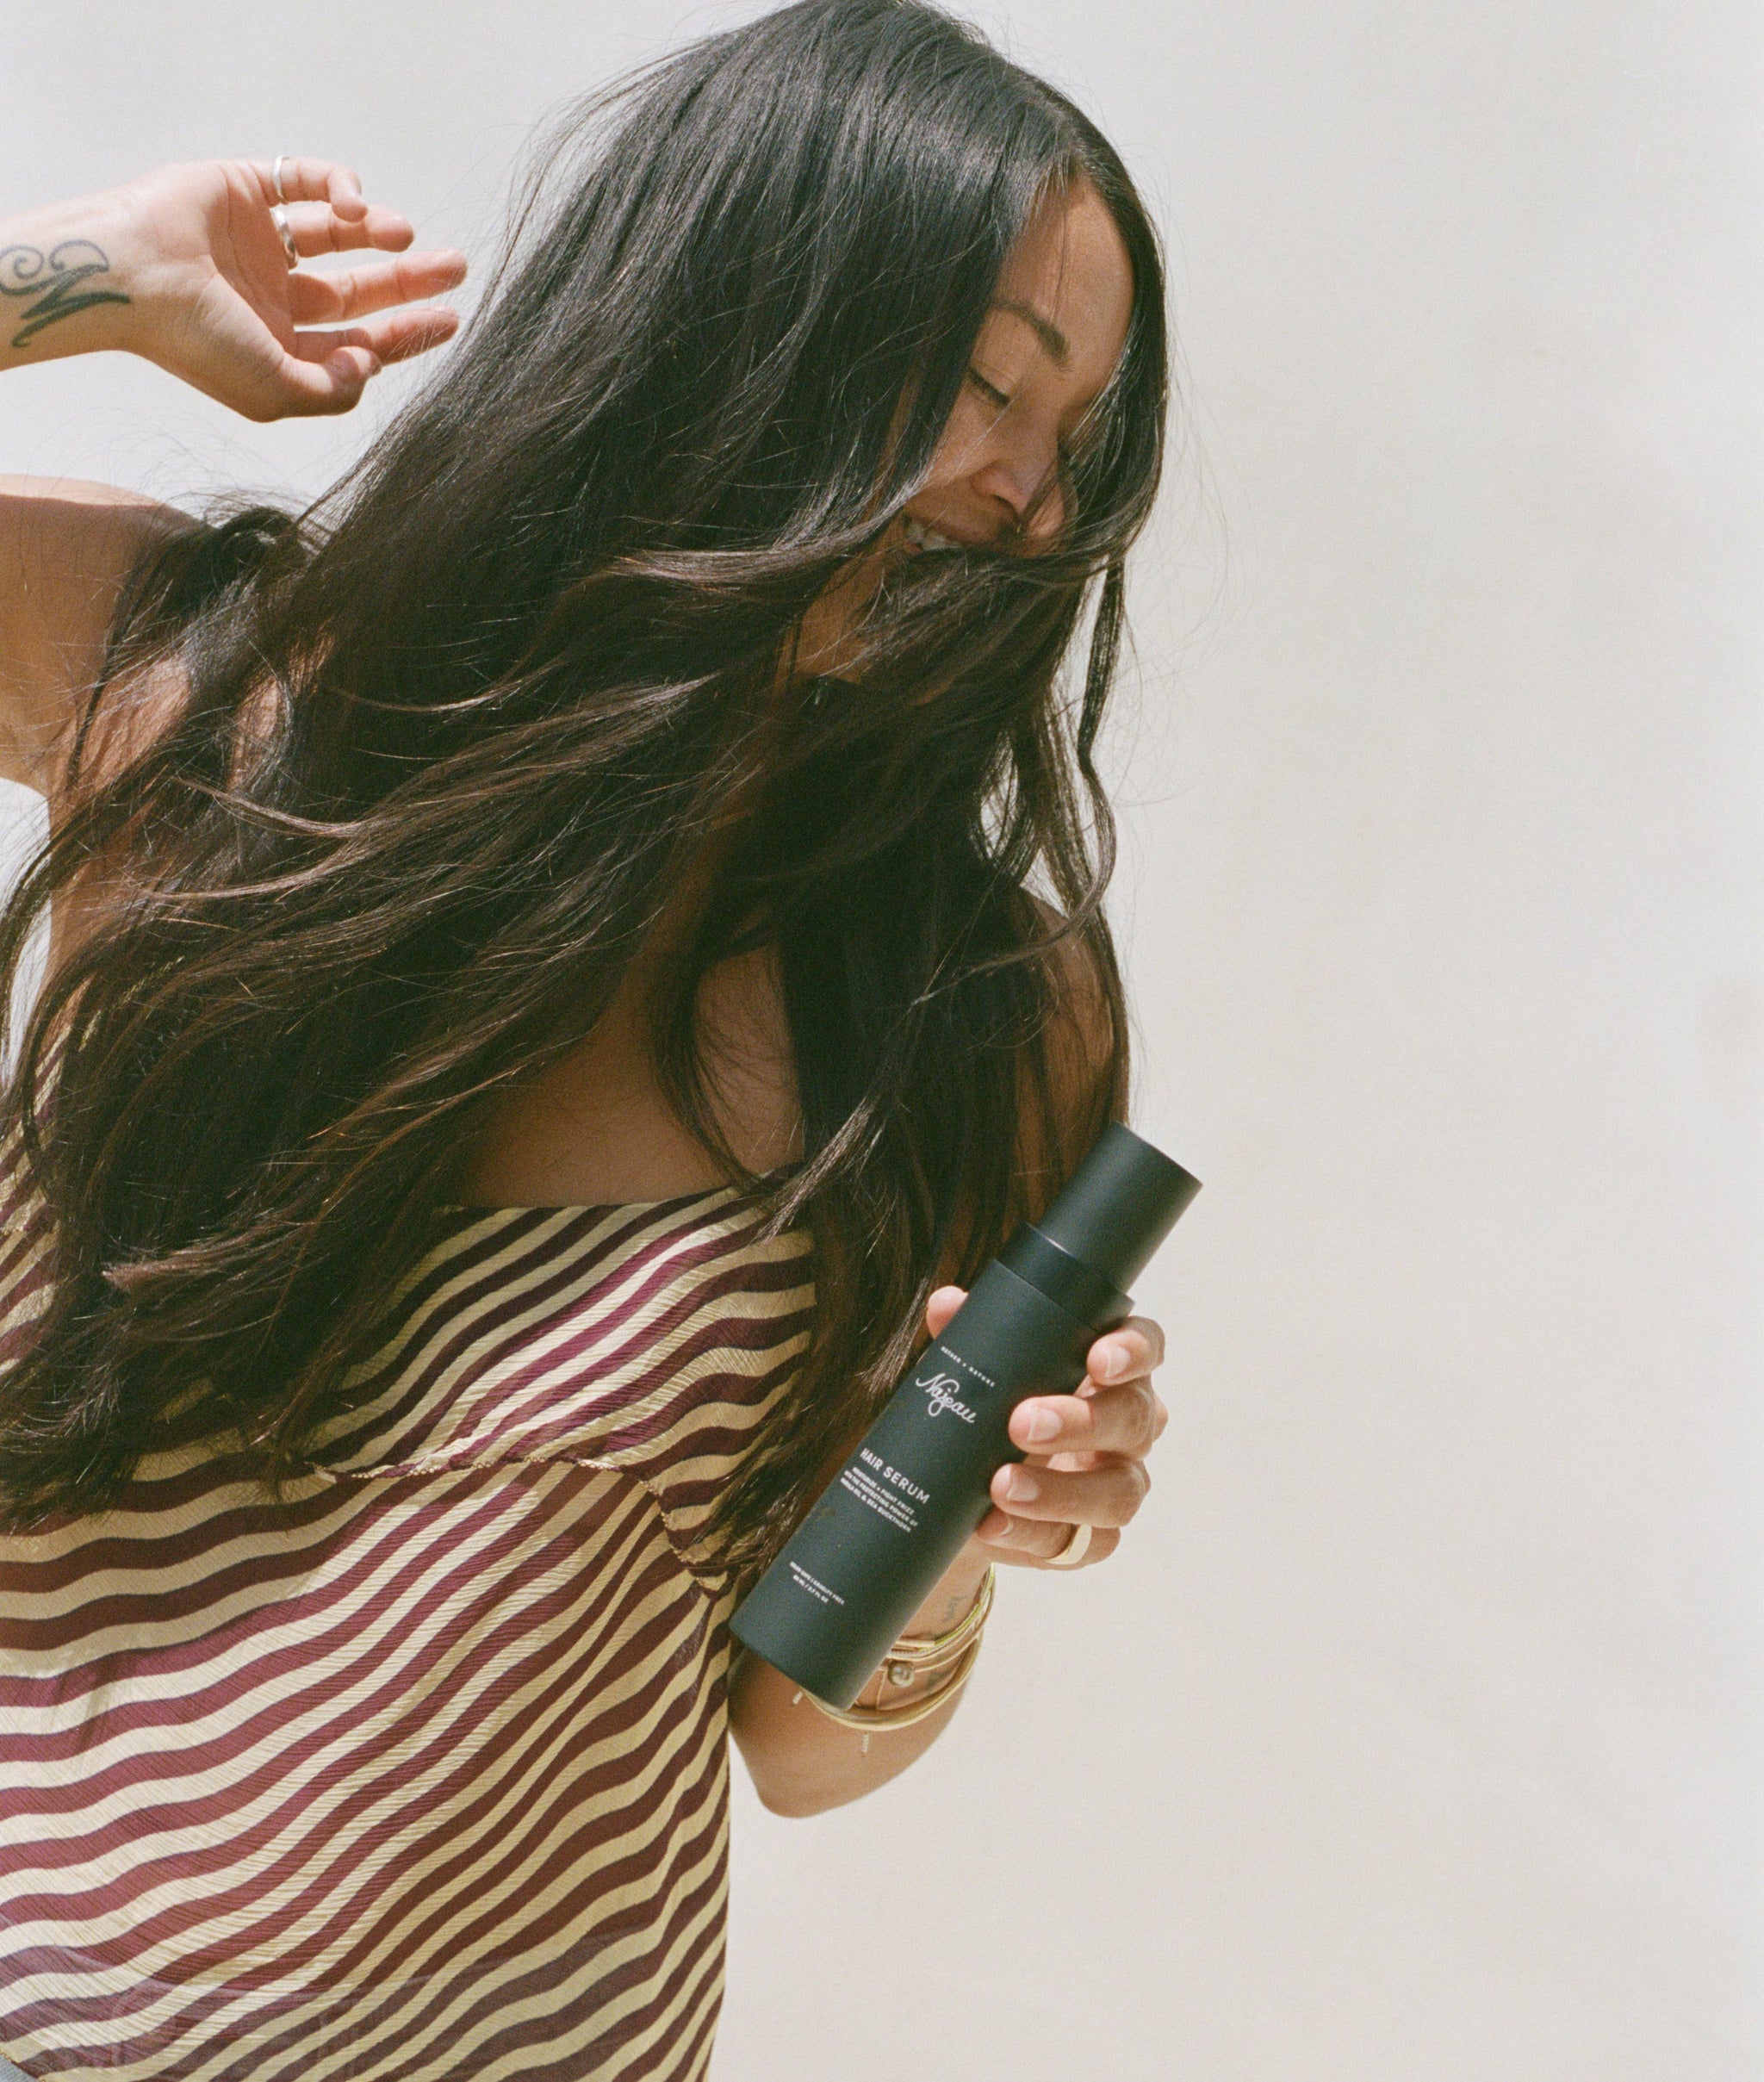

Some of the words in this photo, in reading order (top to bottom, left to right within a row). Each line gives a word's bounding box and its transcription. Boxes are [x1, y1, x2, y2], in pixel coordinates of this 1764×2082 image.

[968, 1366, 995, 1388] NATURE
[916, 1373, 976, 1423] Najeau
[860, 1447, 883, 1470] HAIR
[883, 1466, 930, 1504] SERUM
[859, 1482, 890, 1507] PROTECTING
[889, 1505, 910, 1521] POWER
[866, 1499, 878, 1509] SEA
[878, 1506, 911, 1532] BUCKTHORN
[880, 1488, 898, 1503] FIGHT
[897, 1501, 915, 1515] FRIZZ
